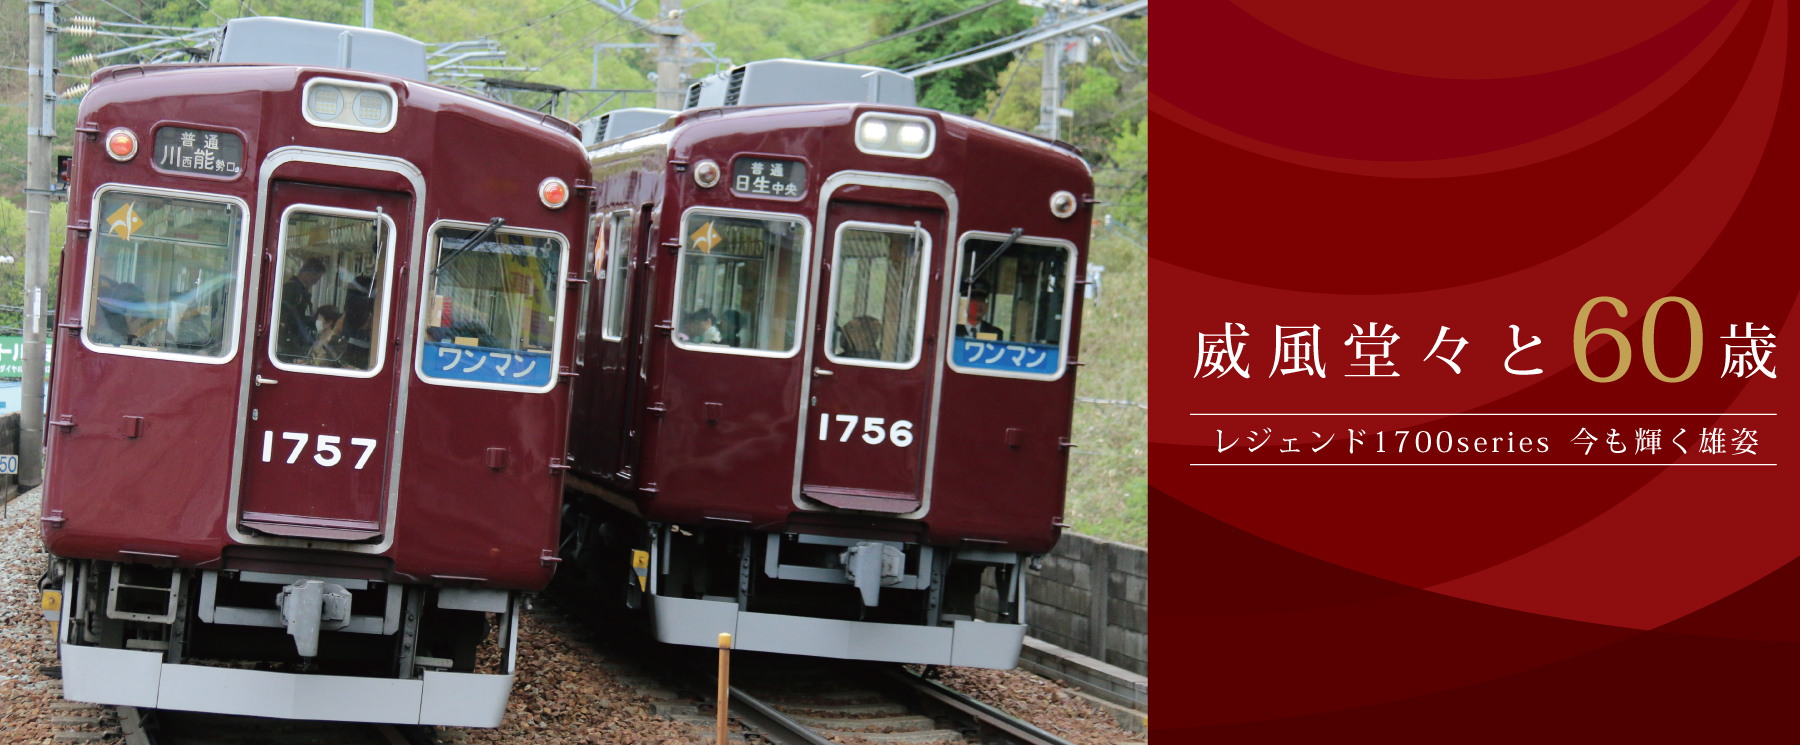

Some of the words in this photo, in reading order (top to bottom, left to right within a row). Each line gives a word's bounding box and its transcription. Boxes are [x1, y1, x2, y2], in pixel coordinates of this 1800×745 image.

[181, 132, 219, 150] 普通
[160, 145, 236, 172] 川西能勢口
[750, 161, 784, 177] 普通
[736, 175, 798, 196] 日生中央
[438, 347, 536, 378] ワンマン
[965, 341, 1046, 368] ワンマン
[819, 413, 913, 447] 1756
[262, 430, 377, 470] 1757
